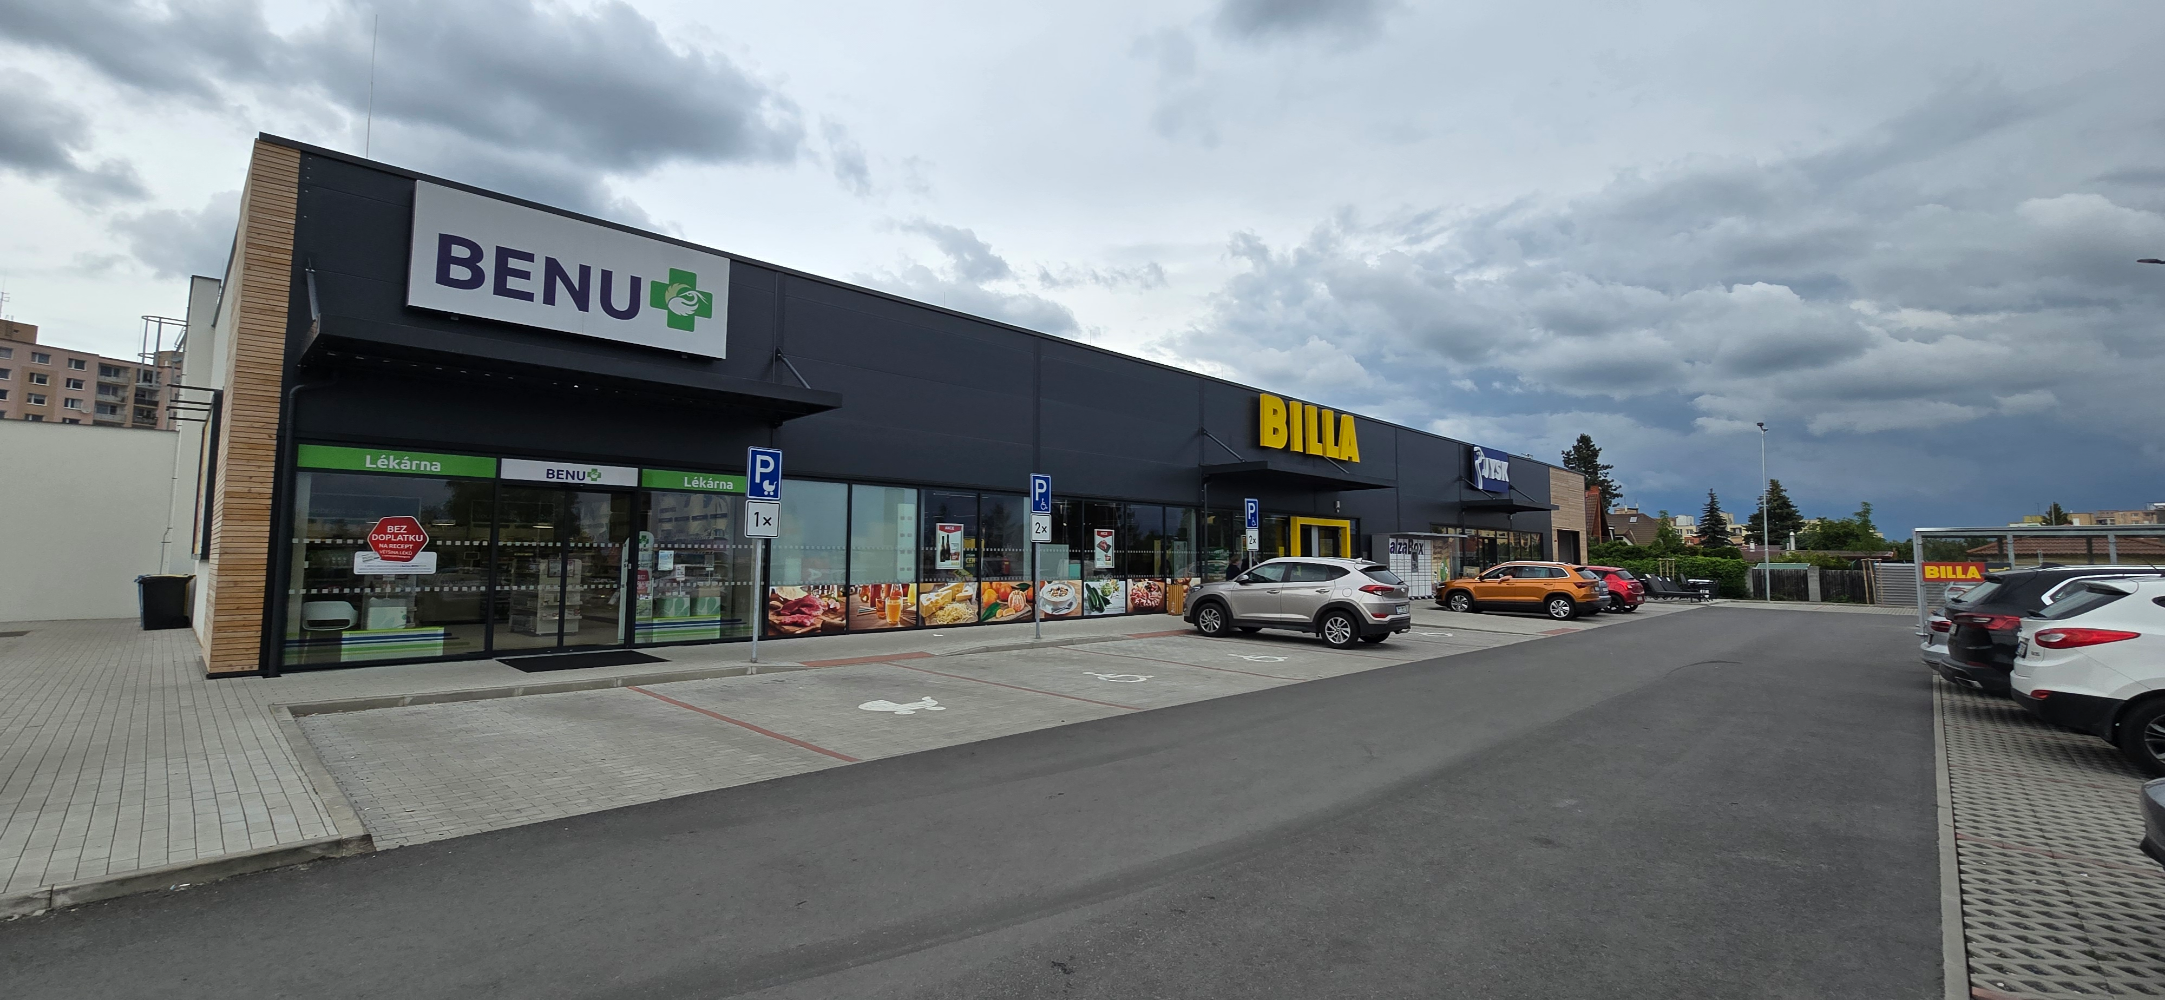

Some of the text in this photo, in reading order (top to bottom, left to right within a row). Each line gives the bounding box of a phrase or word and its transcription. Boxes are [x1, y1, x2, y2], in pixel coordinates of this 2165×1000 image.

[435, 232, 642, 320] BENU
[1260, 393, 1360, 463] BILLA
[365, 454, 441, 472] Lékárna
[755, 454, 775, 484] P
[1482, 457, 1509, 482] JYSK
[546, 468, 586, 481] BENU
[684, 477, 734, 490] Lékárna
[1035, 479, 1047, 501] P
[1247, 502, 1256, 520] P
[371, 533, 424, 542] DOPLATKU
[386, 525, 408, 533] BEZ
[1924, 565, 1982, 579] BILLA
